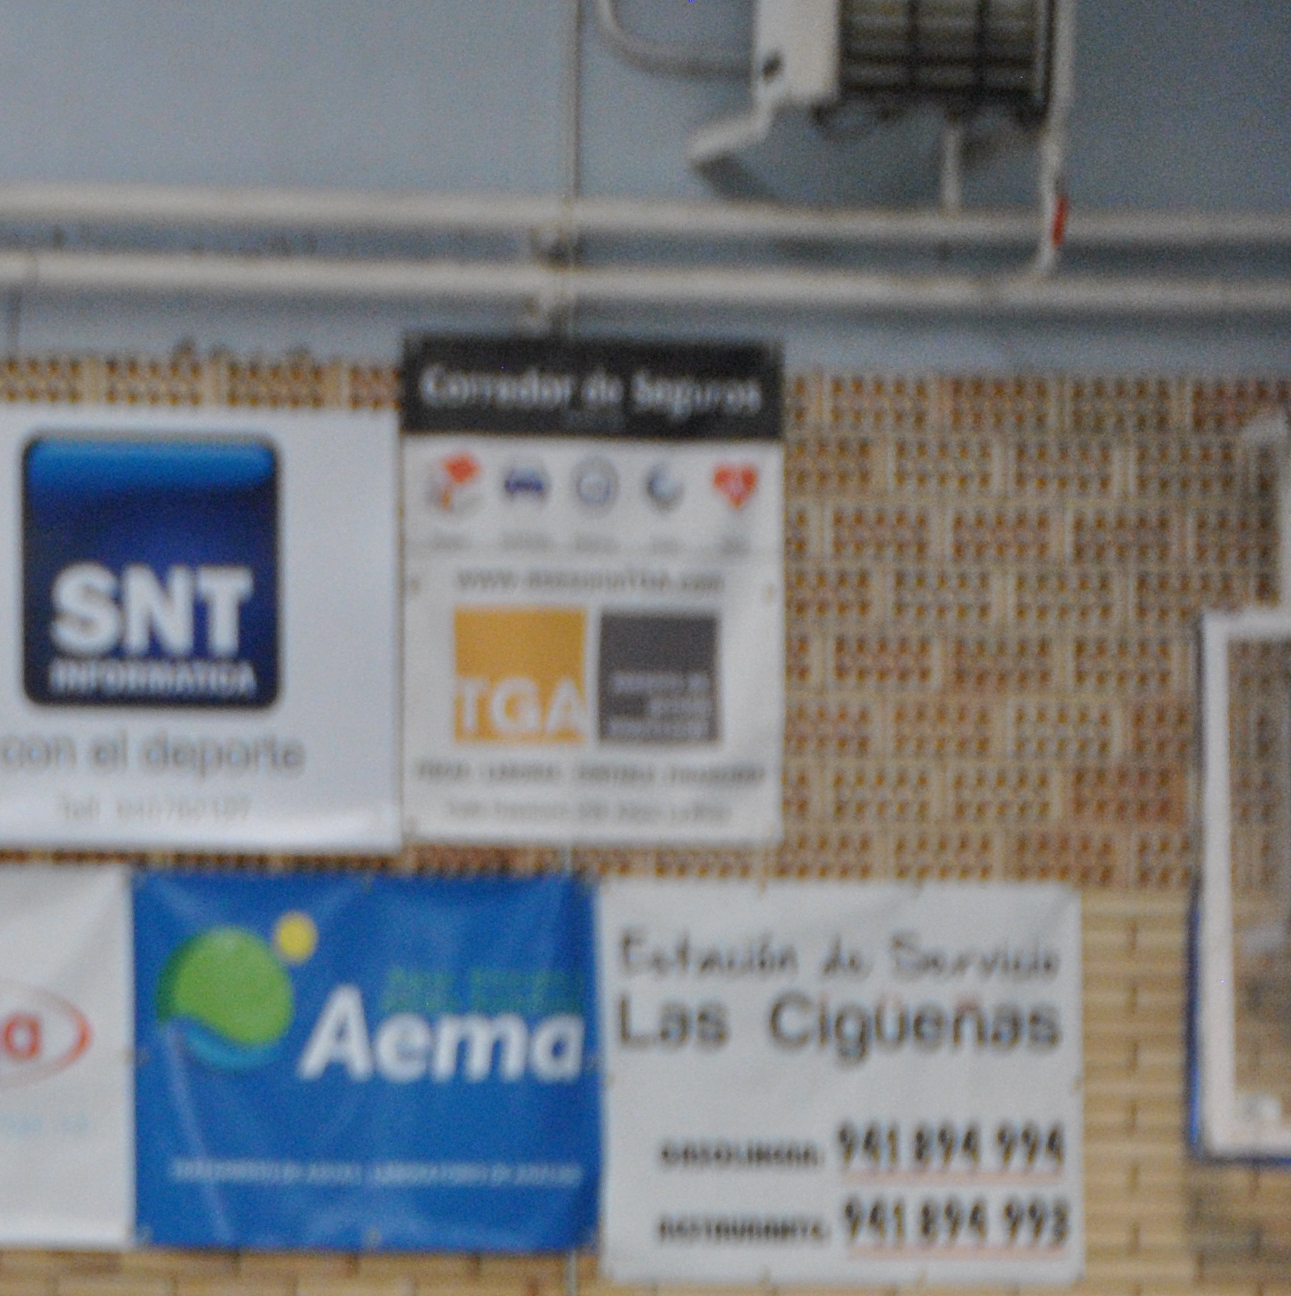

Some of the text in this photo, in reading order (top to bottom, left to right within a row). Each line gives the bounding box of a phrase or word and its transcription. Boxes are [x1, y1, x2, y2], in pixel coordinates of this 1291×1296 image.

[48, 561, 255, 660] SNT
[456, 672, 587, 743] TGA
[90, 728, 127, 772] el
[140, 730, 307, 782] deporte
[618, 990, 729, 1052] Las
[769, 988, 1062, 1067] Cigüeñas
[837, 1117, 903, 1169] 941
[843, 1196, 907, 1244] 941
